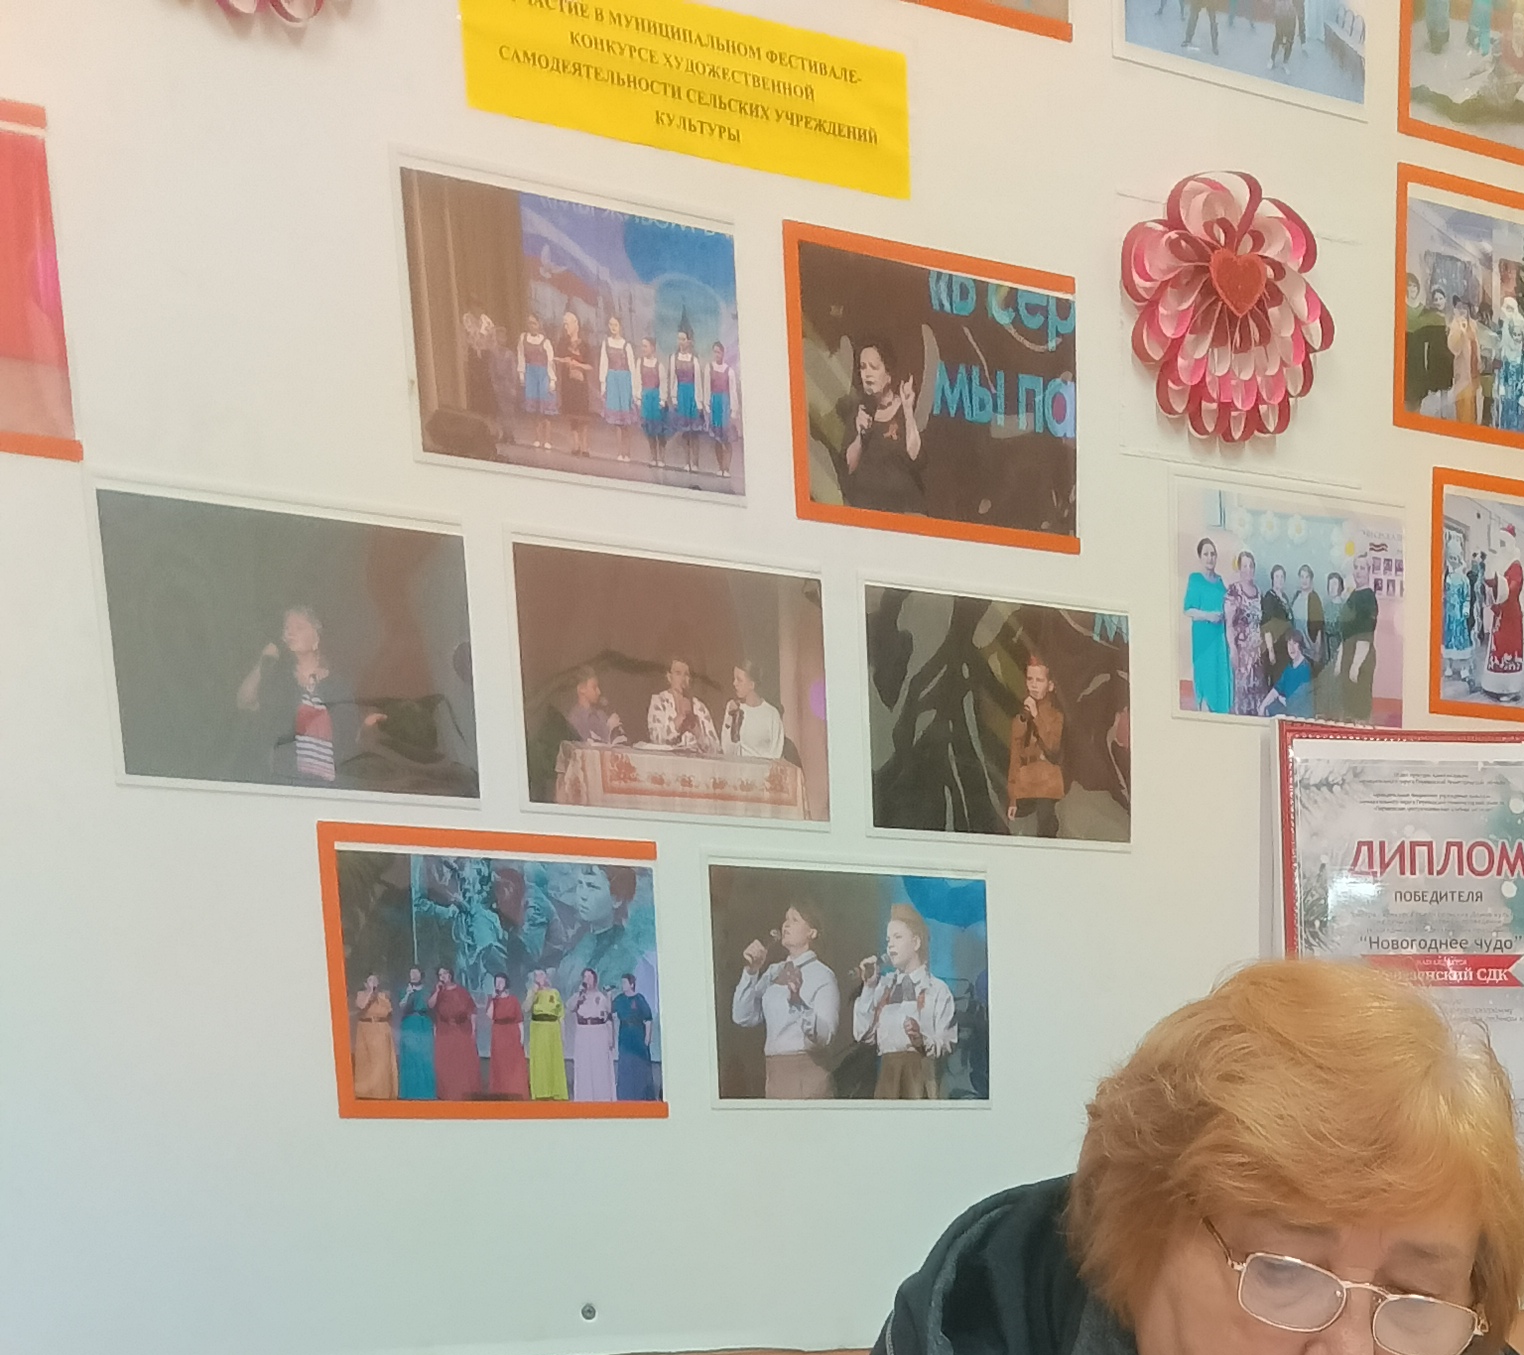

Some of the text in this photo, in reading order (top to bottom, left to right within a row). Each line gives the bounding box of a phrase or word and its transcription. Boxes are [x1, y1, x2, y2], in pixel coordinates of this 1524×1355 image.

[512, 0, 862, 84] АСТИЕ В МУНИЦИПАЛЬНОМ ФЕСТИВАЛЕ-
[569, 31, 815, 102] КОНКУРСЕ ХУДОЖЕСТВЕННОЙ
[498, 45, 878, 146] САМОДЕЯТЕЛЬНОСТИ СЕЛЬСКИХ УЧРЕЖДЕНИЙ
[655, 109, 741, 144] КУЛЬТУРЫ
[1394, 890, 1483, 905] ПОБЕДИТЕЛЯ
[1476, 967, 1509, 984] СДК
